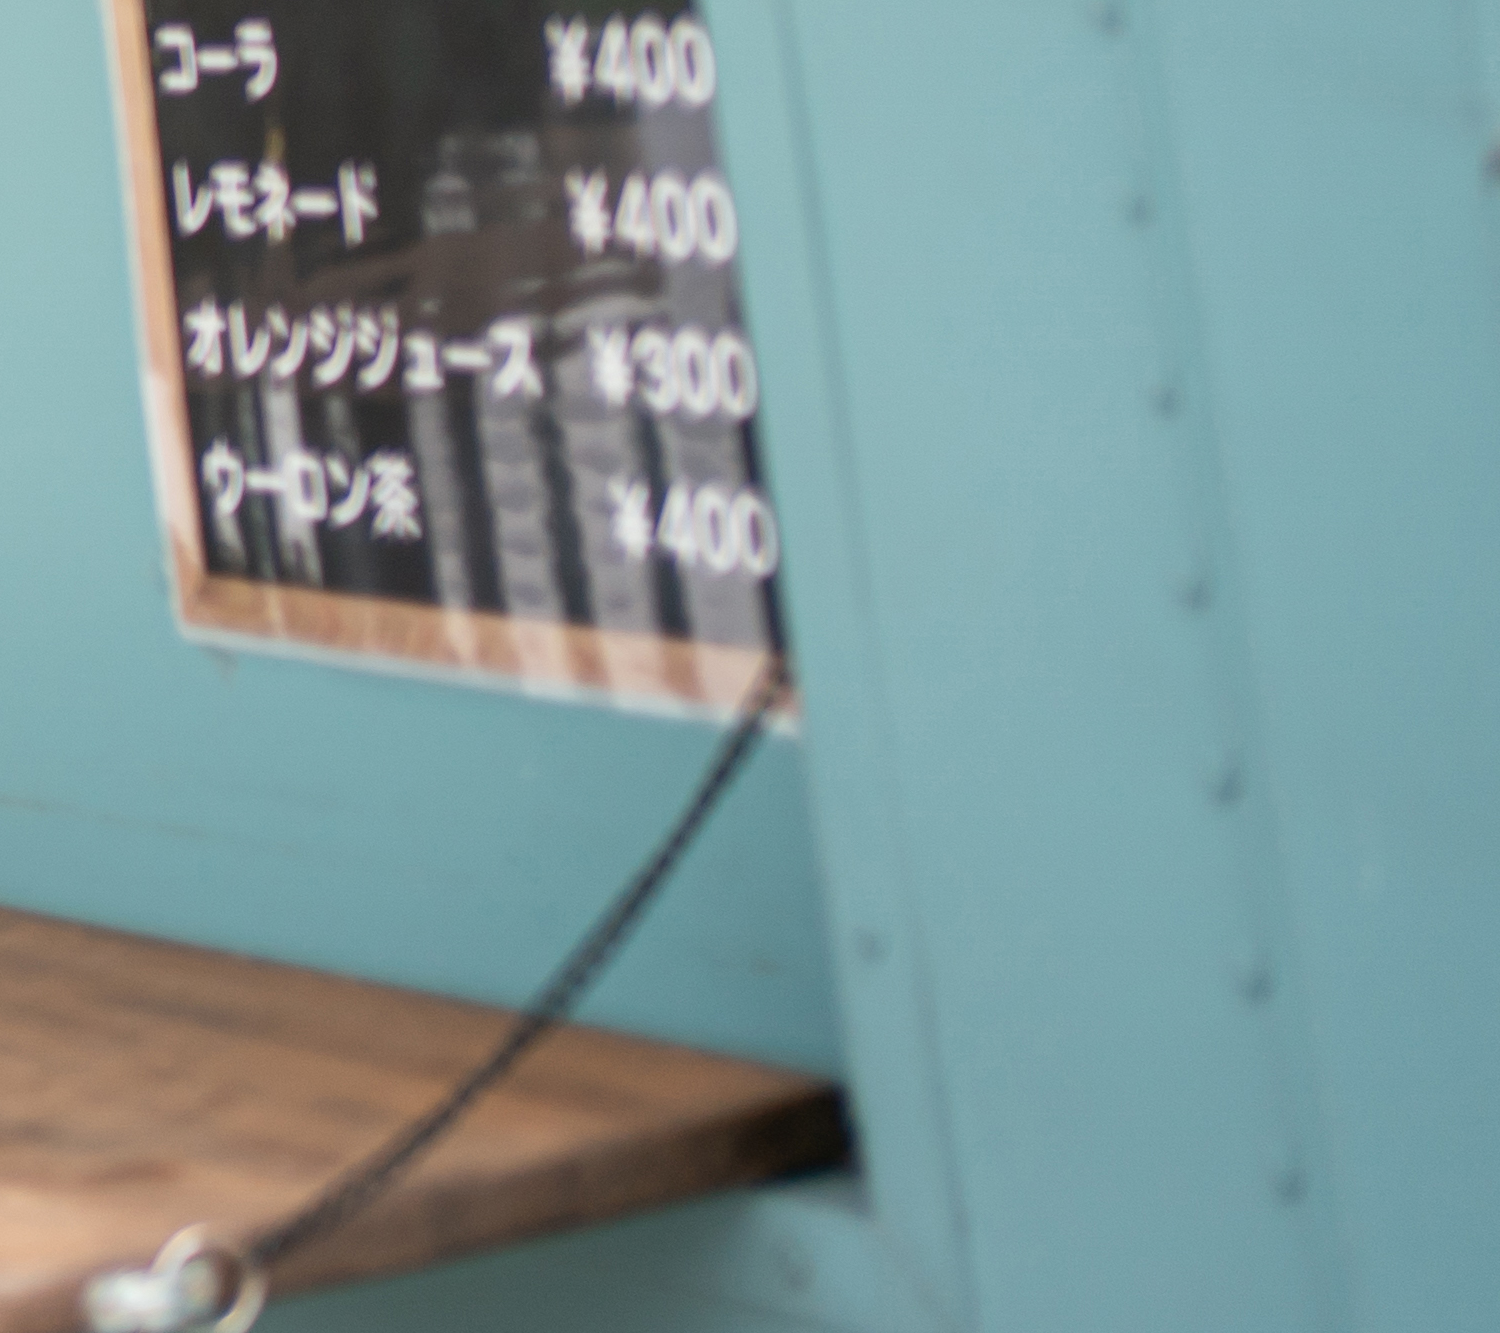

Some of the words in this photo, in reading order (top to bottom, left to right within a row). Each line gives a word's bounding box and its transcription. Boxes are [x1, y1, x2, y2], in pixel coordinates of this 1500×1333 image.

[154, 17, 279, 101] コーラ
[546, 10, 717, 105] ¥400
[173, 157, 379, 247] レモネード
[567, 168, 740, 265] ¥400
[184, 299, 544, 399] オレンジジュース
[587, 325, 760, 421] ¥300
[202, 439, 422, 543] ウーロン茶
[609, 476, 780, 575] ¥400
